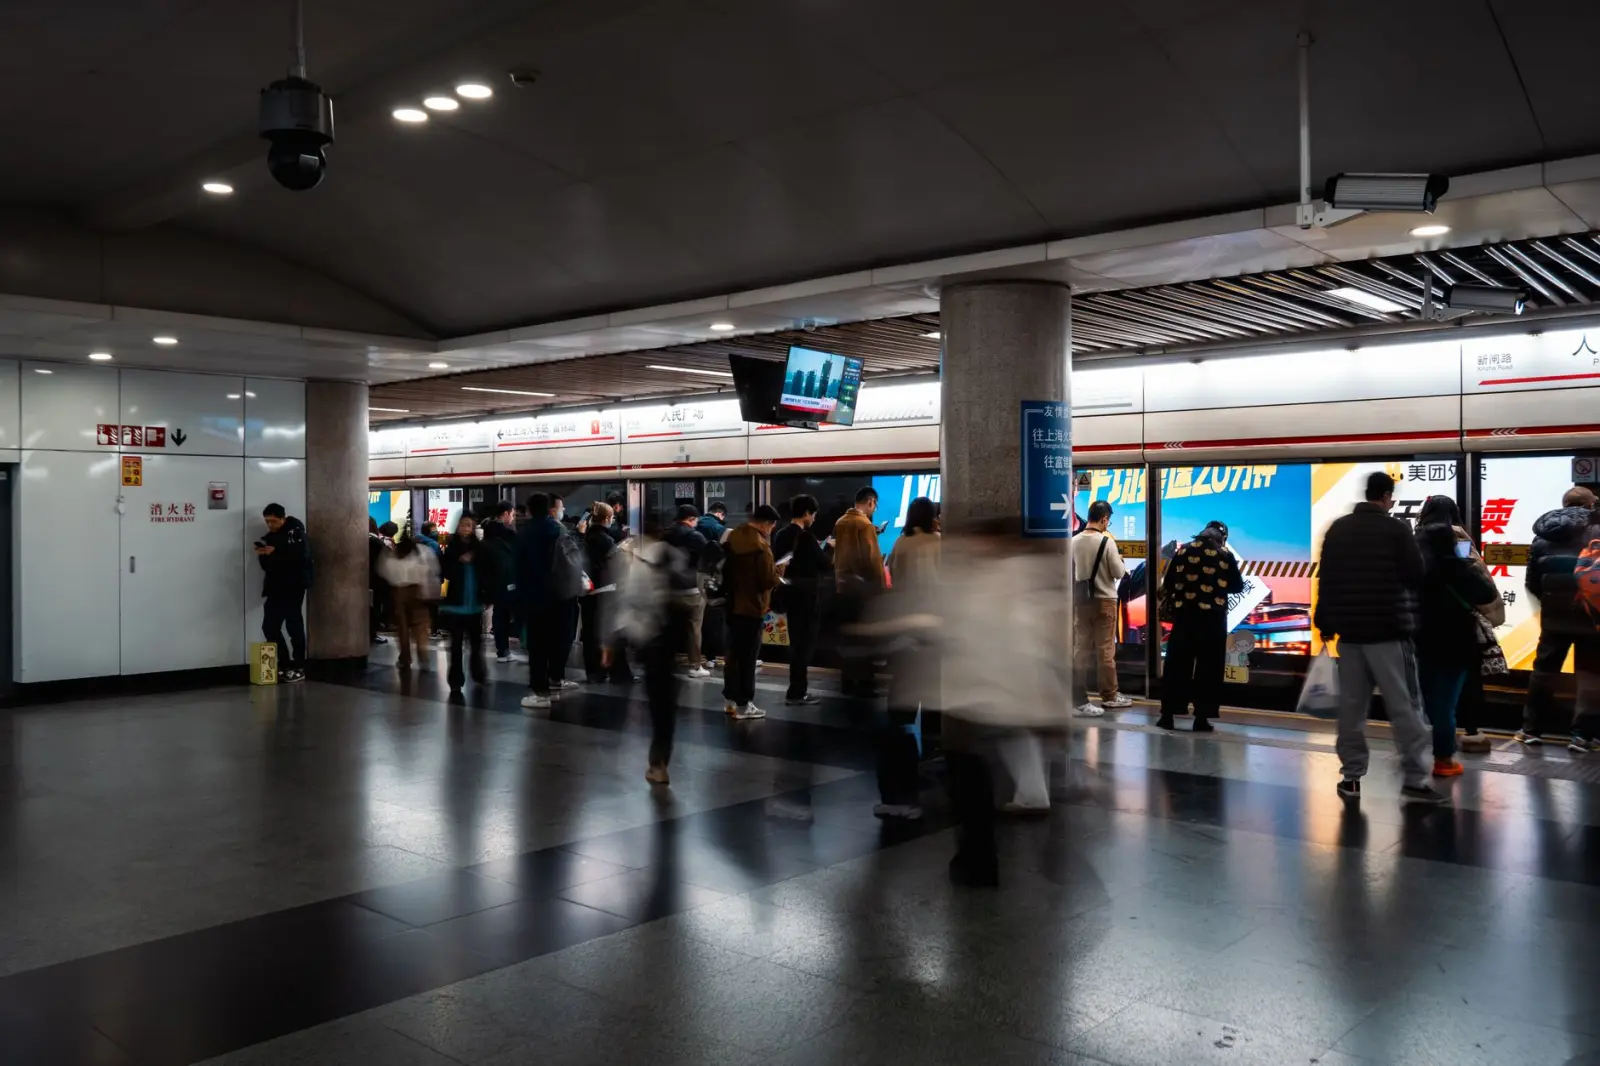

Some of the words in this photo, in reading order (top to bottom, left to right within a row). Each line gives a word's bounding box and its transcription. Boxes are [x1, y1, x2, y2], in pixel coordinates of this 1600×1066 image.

[1477, 353, 1512, 366] 新闸路
[150, 503, 196, 515] 消火栓
[1226, 578, 1256, 614] 团外卖
